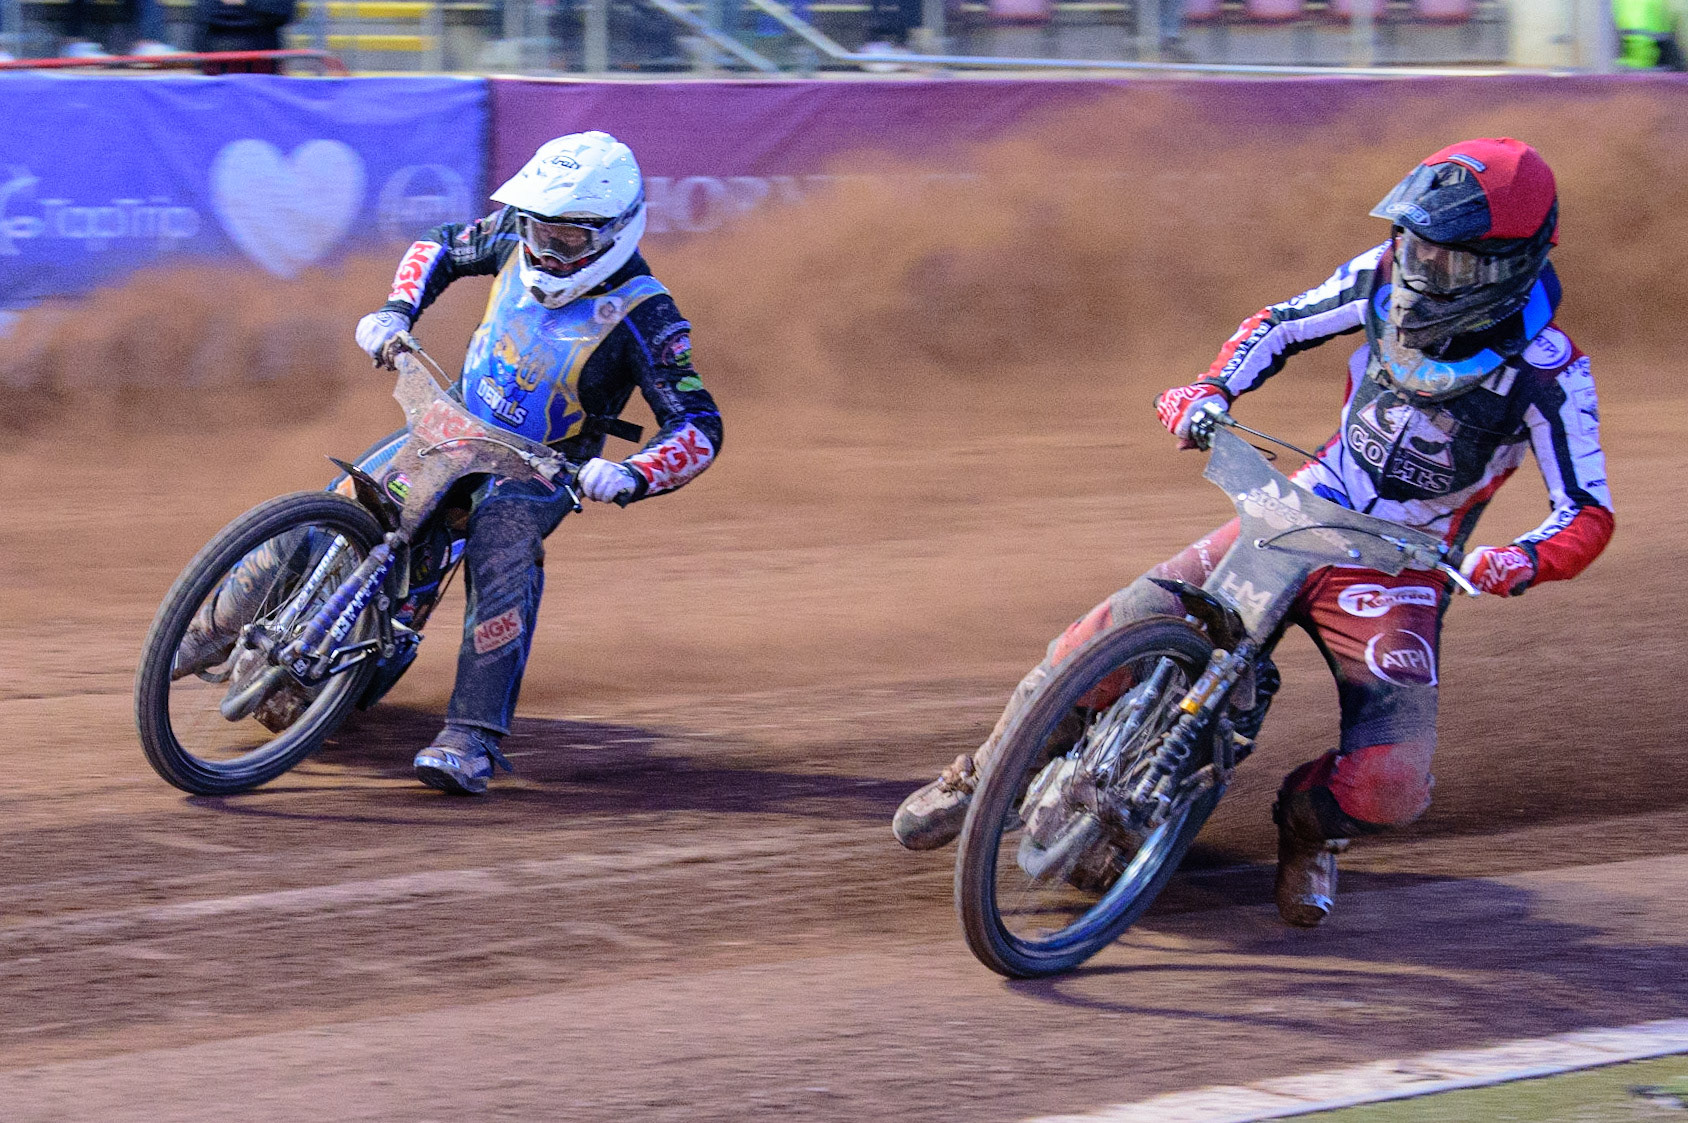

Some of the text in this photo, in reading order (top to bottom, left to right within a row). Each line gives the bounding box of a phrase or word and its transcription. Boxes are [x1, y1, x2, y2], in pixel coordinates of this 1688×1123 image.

[399, 243, 435, 303] NGK
[476, 378, 526, 425] DEVILS
[632, 430, 709, 483] NGK
[478, 612, 517, 643] NGK
[1382, 650, 1428, 669] ATPI
